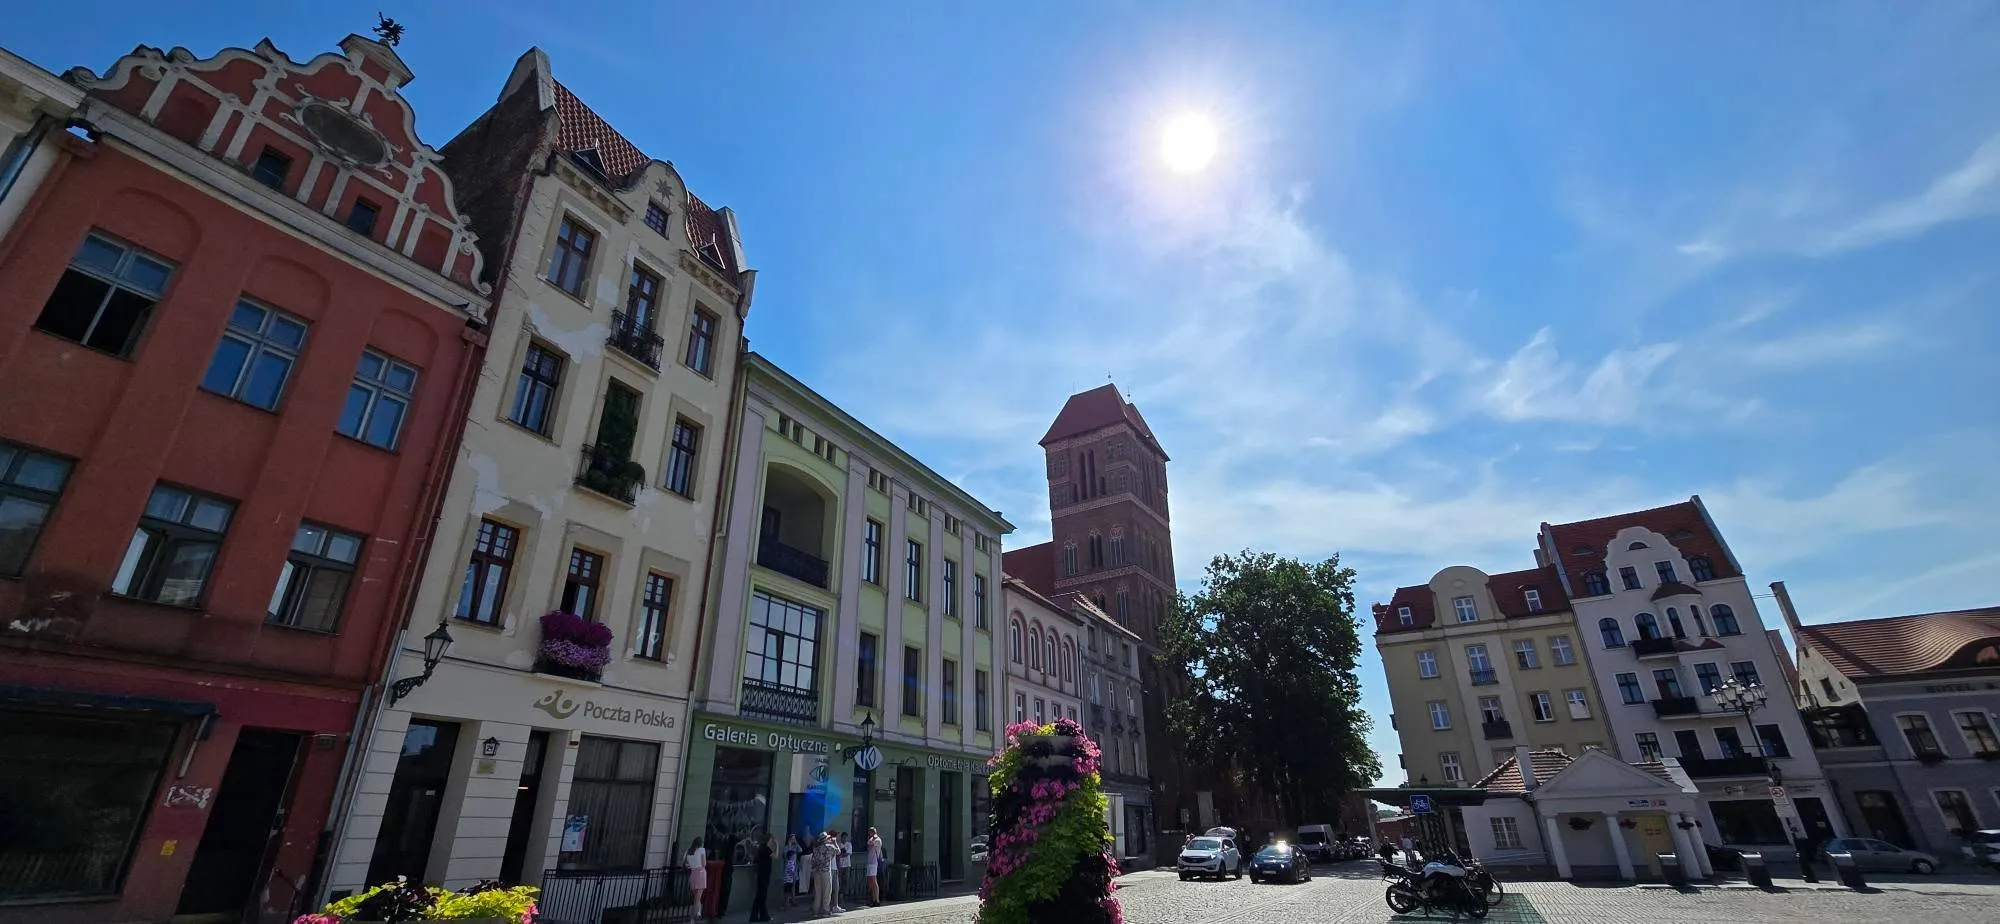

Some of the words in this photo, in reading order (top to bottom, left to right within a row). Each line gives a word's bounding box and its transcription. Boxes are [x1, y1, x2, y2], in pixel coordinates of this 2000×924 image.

[583, 700, 631, 723] Poczta
[634, 708, 675, 729] Polska
[704, 723, 759, 746] Galeria
[768, 732, 829, 753] Optyczna
